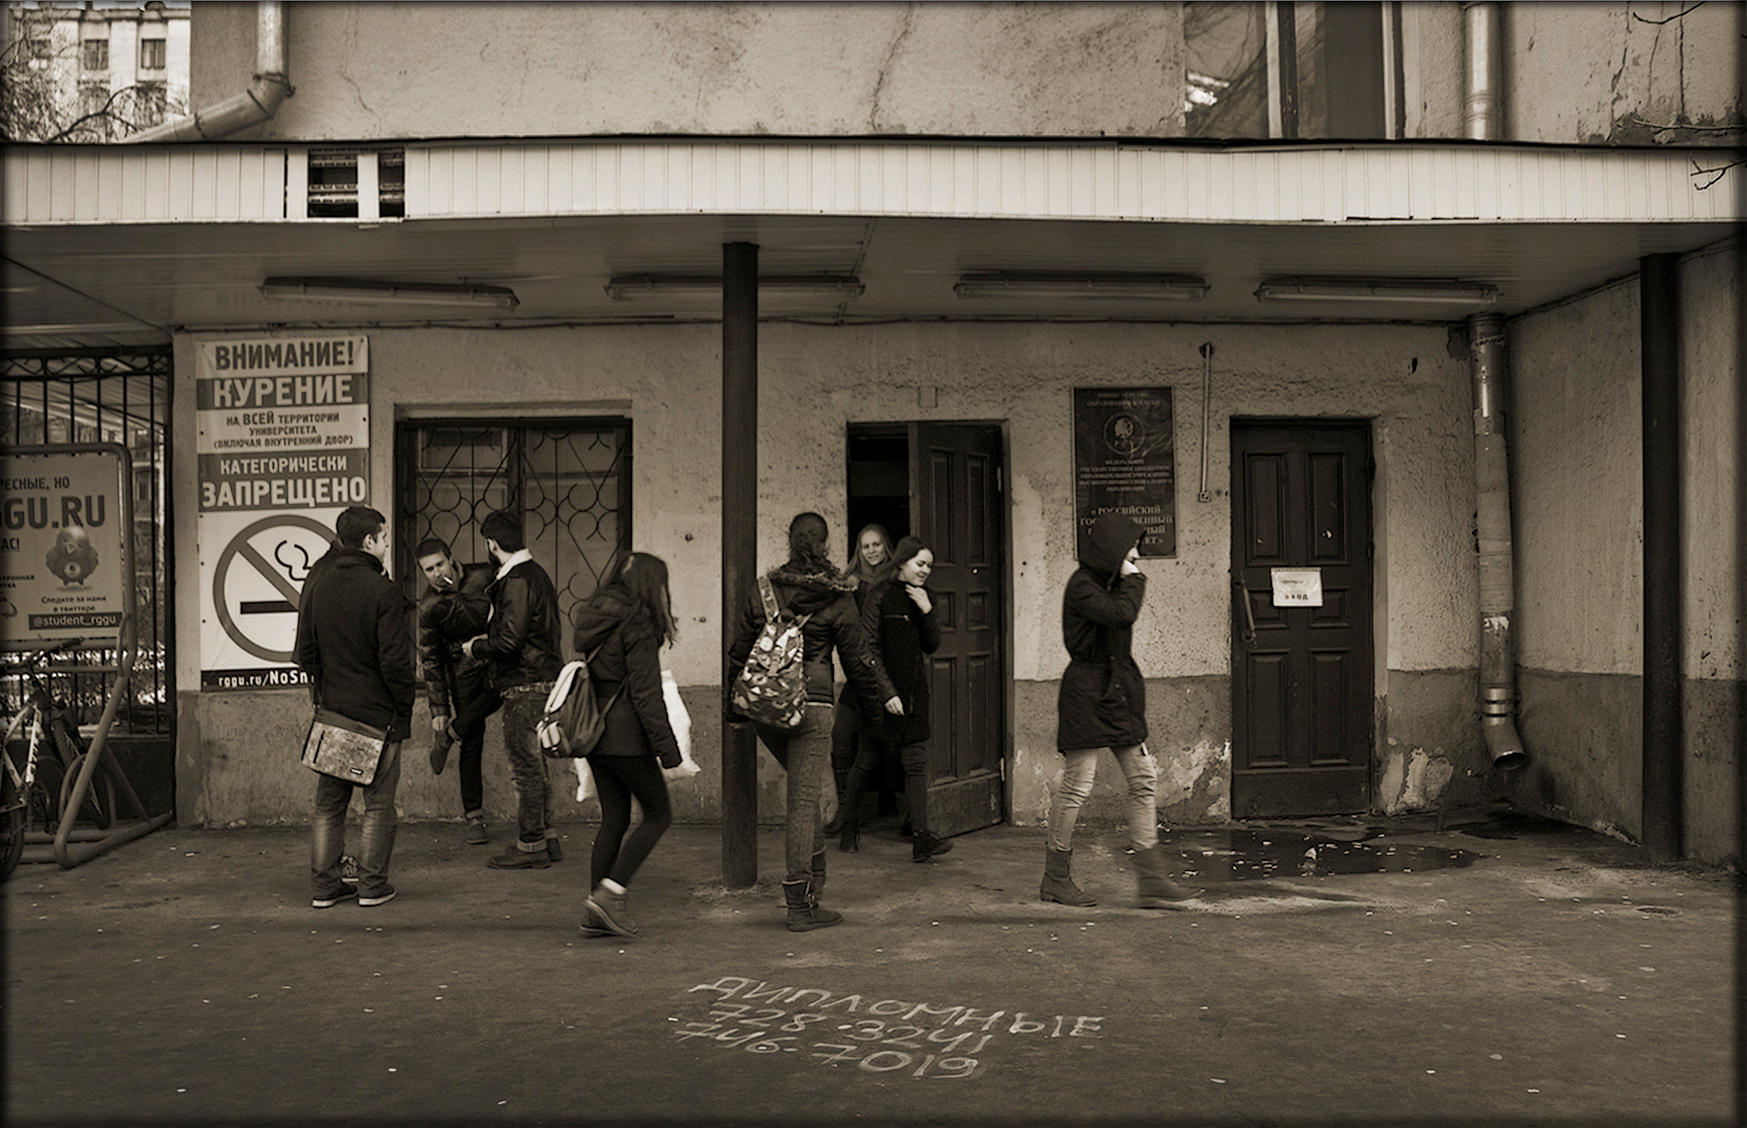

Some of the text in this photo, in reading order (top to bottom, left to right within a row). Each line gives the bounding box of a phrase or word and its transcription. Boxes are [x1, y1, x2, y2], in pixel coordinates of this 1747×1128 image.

[215, 341, 354, 371] ВНИМАНИЕ!
[213, 375, 353, 409] КУРЕНИЕ
[226, 411, 340, 426] НА ВСЕЙ ТЕРРИТОРИИ
[249, 425, 317, 436] УНИВЕРСИТЕТА
[213, 435, 354, 449] (ВКЛЮЧАЯ ВНУТРЕННИЙ ДВОР)
[220, 455, 347, 475] КАТЕГОРИЧЕСКИ
[54, 476, 70, 489] НО
[202, 476, 366, 508] ЗАПРЕЩЕНО
[0, 494, 105, 530] GU.RU
[0, 538, 20, 549] АС!
[32, 615, 117, 628] @student_rggu
[687, 976, 1104, 1038] ДИПЛОМНЫЕ
